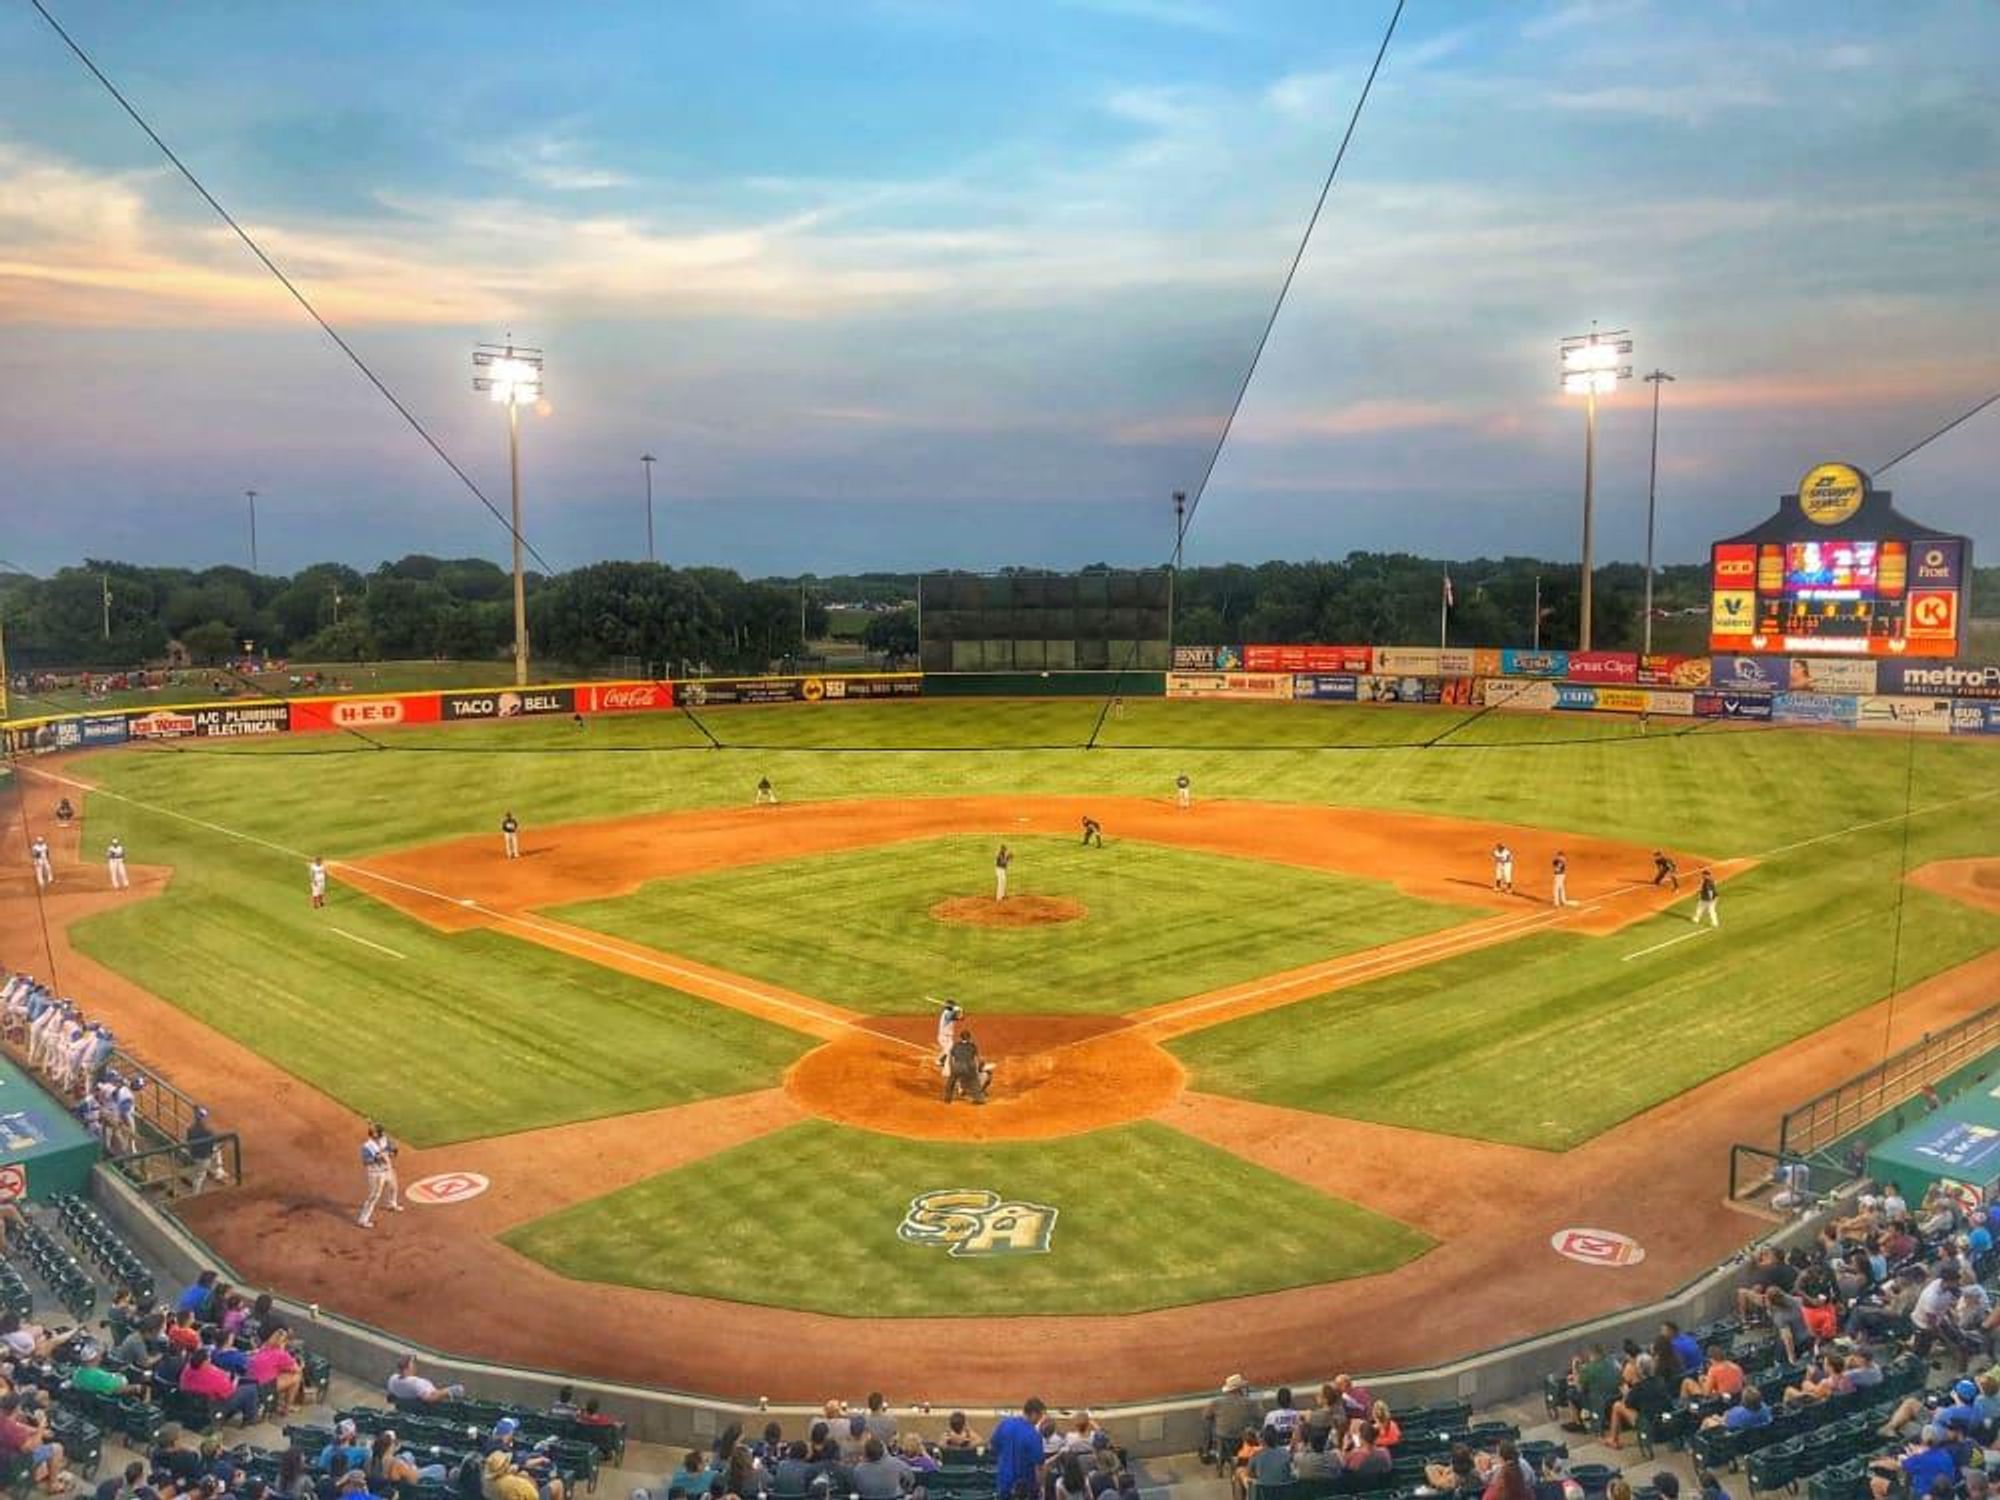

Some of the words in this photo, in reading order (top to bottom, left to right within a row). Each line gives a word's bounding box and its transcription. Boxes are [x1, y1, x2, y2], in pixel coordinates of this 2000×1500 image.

[1918, 565, 1950, 578] Frost
[1568, 659, 1602, 672] Great
[1604, 659, 1636, 675] Clips
[453, 700, 493, 715] TACO
[524, 696, 561, 710] BELL
[603, 687, 658, 708] Coca-Cola
[197, 711, 219, 724] A/C
[225, 708, 288, 722] PLUMBING
[207, 720, 279, 736] ELECTRICAL
